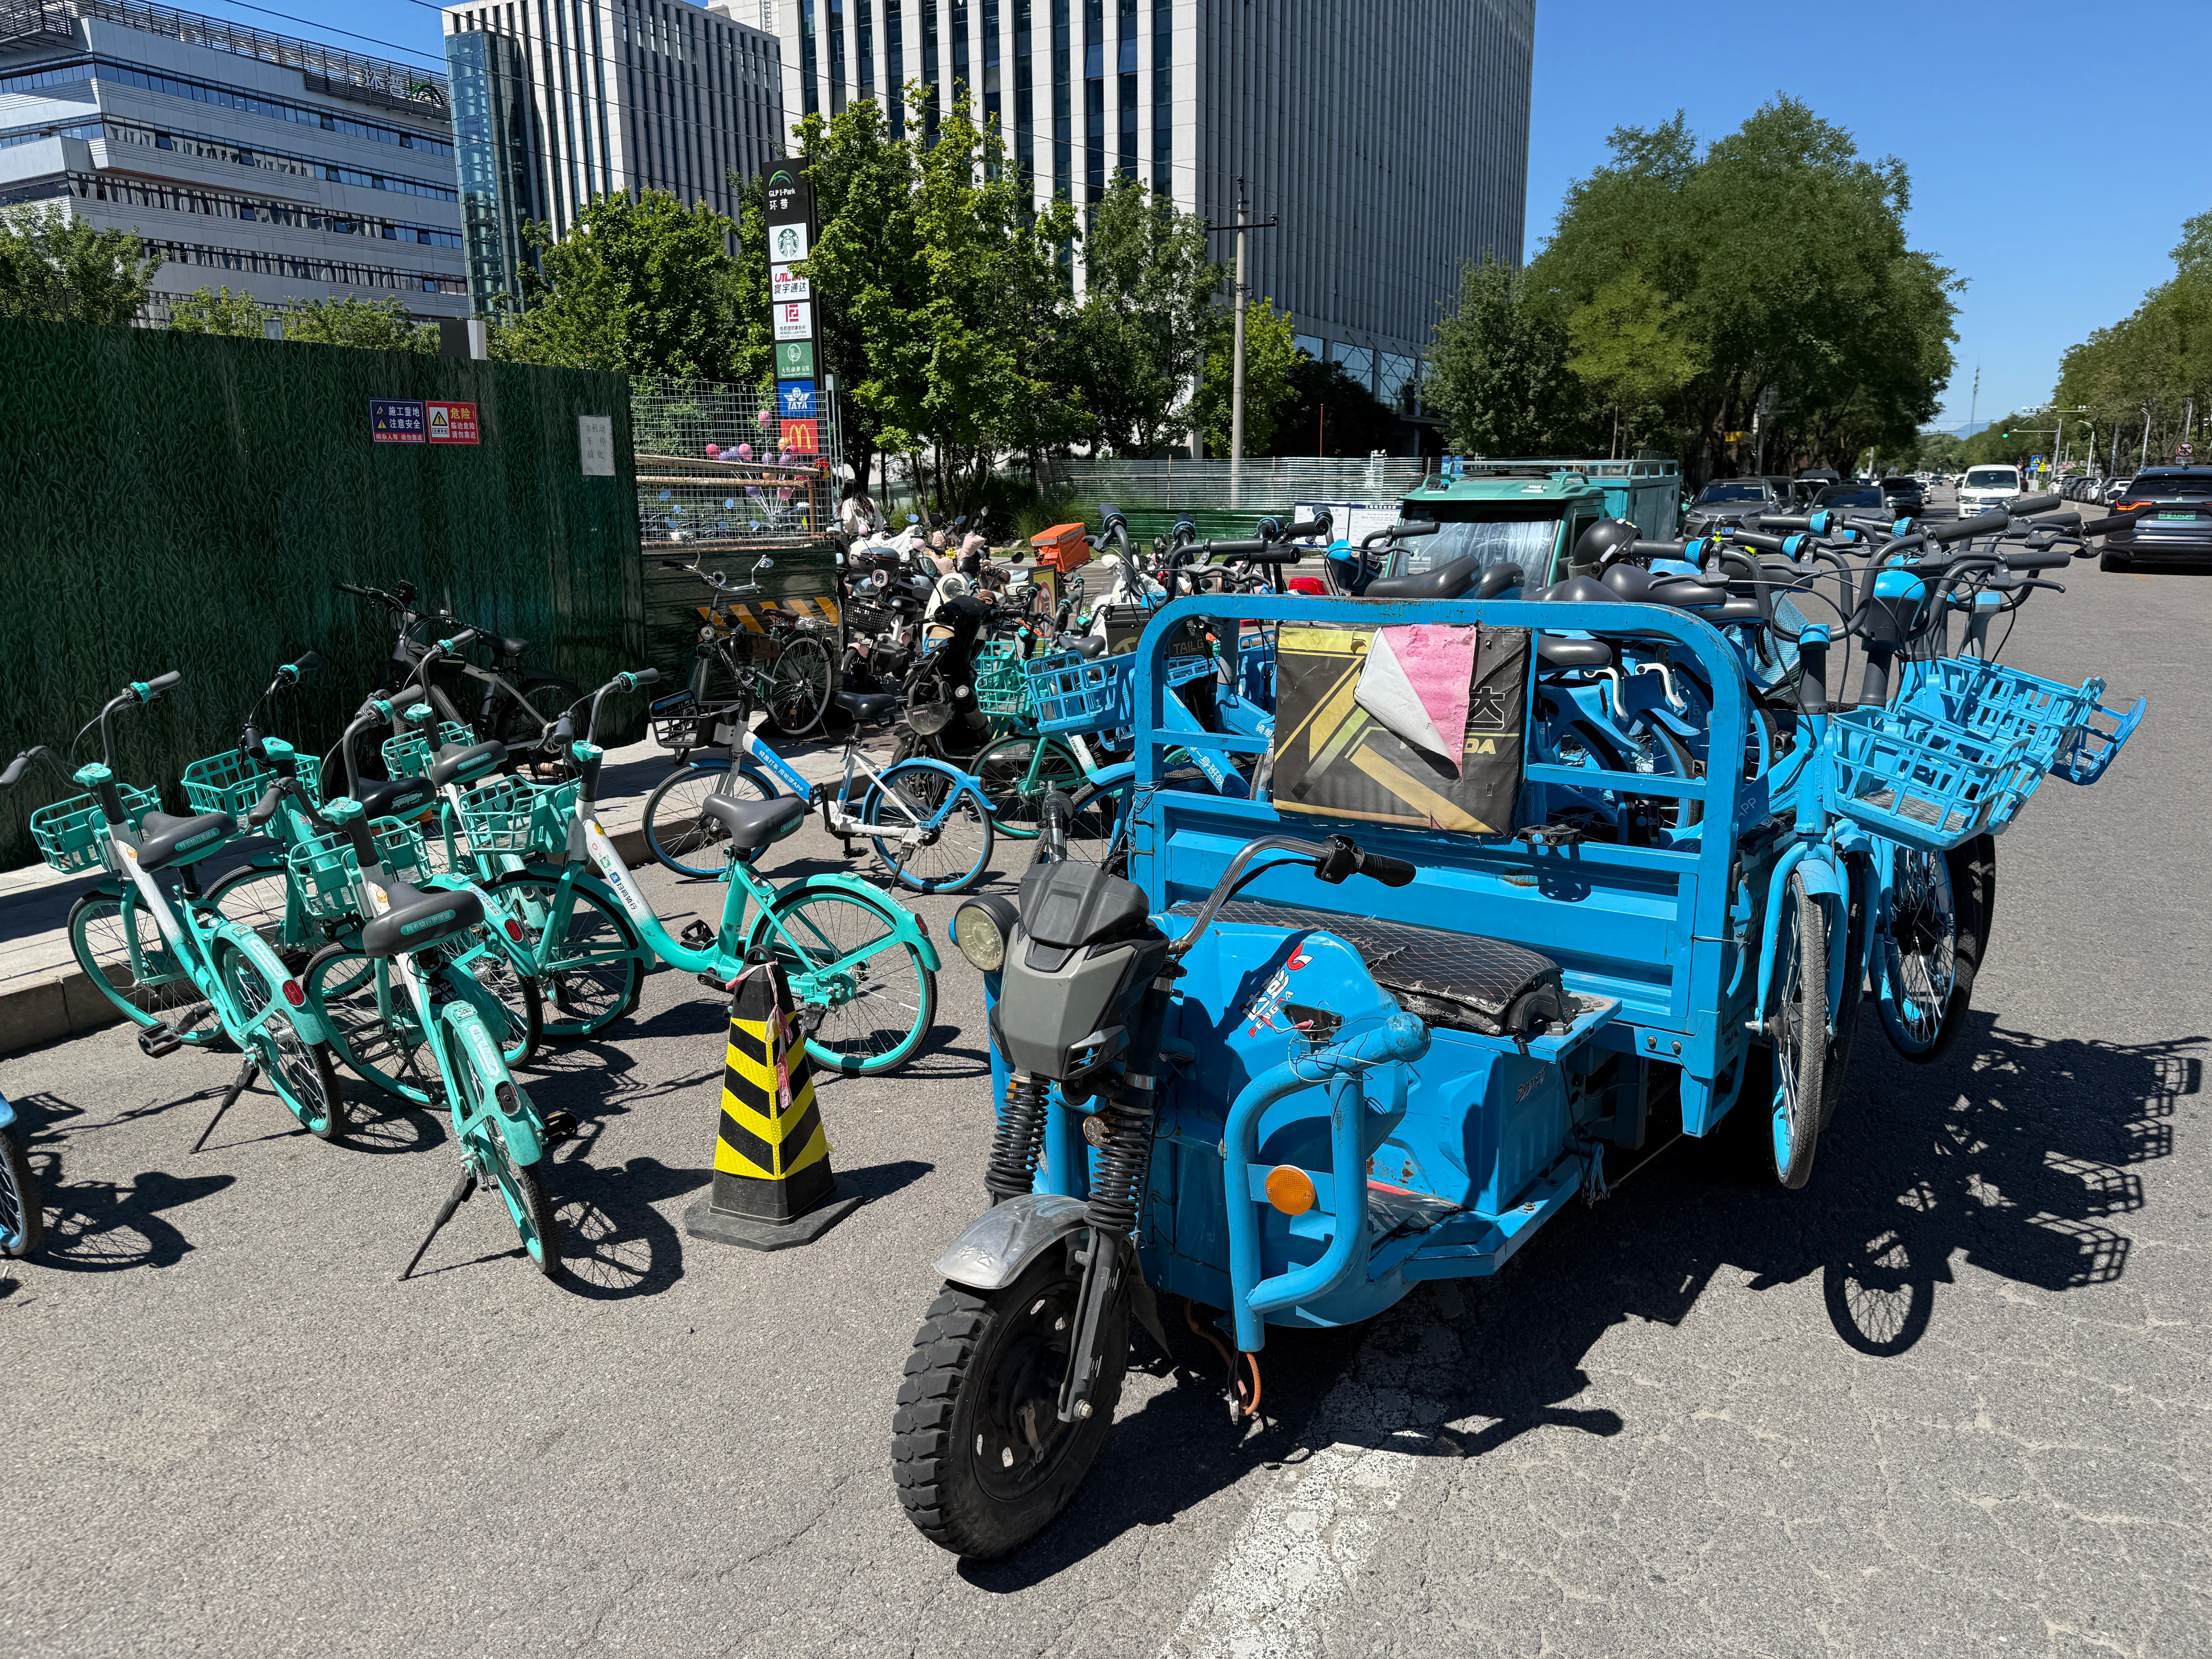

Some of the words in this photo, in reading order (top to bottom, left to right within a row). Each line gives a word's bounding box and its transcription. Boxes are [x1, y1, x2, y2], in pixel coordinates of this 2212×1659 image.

[780, 187, 795, 196] I-Park
[774, 282, 806, 294] 寰宇通达
[788, 402, 807, 410] IATA
[388, 406, 420, 417] 施工重地
[390, 419, 421, 429] 注意安全
[451, 422, 475, 430] 临边危险
[617, 883, 637, 910] 扫码骑行
